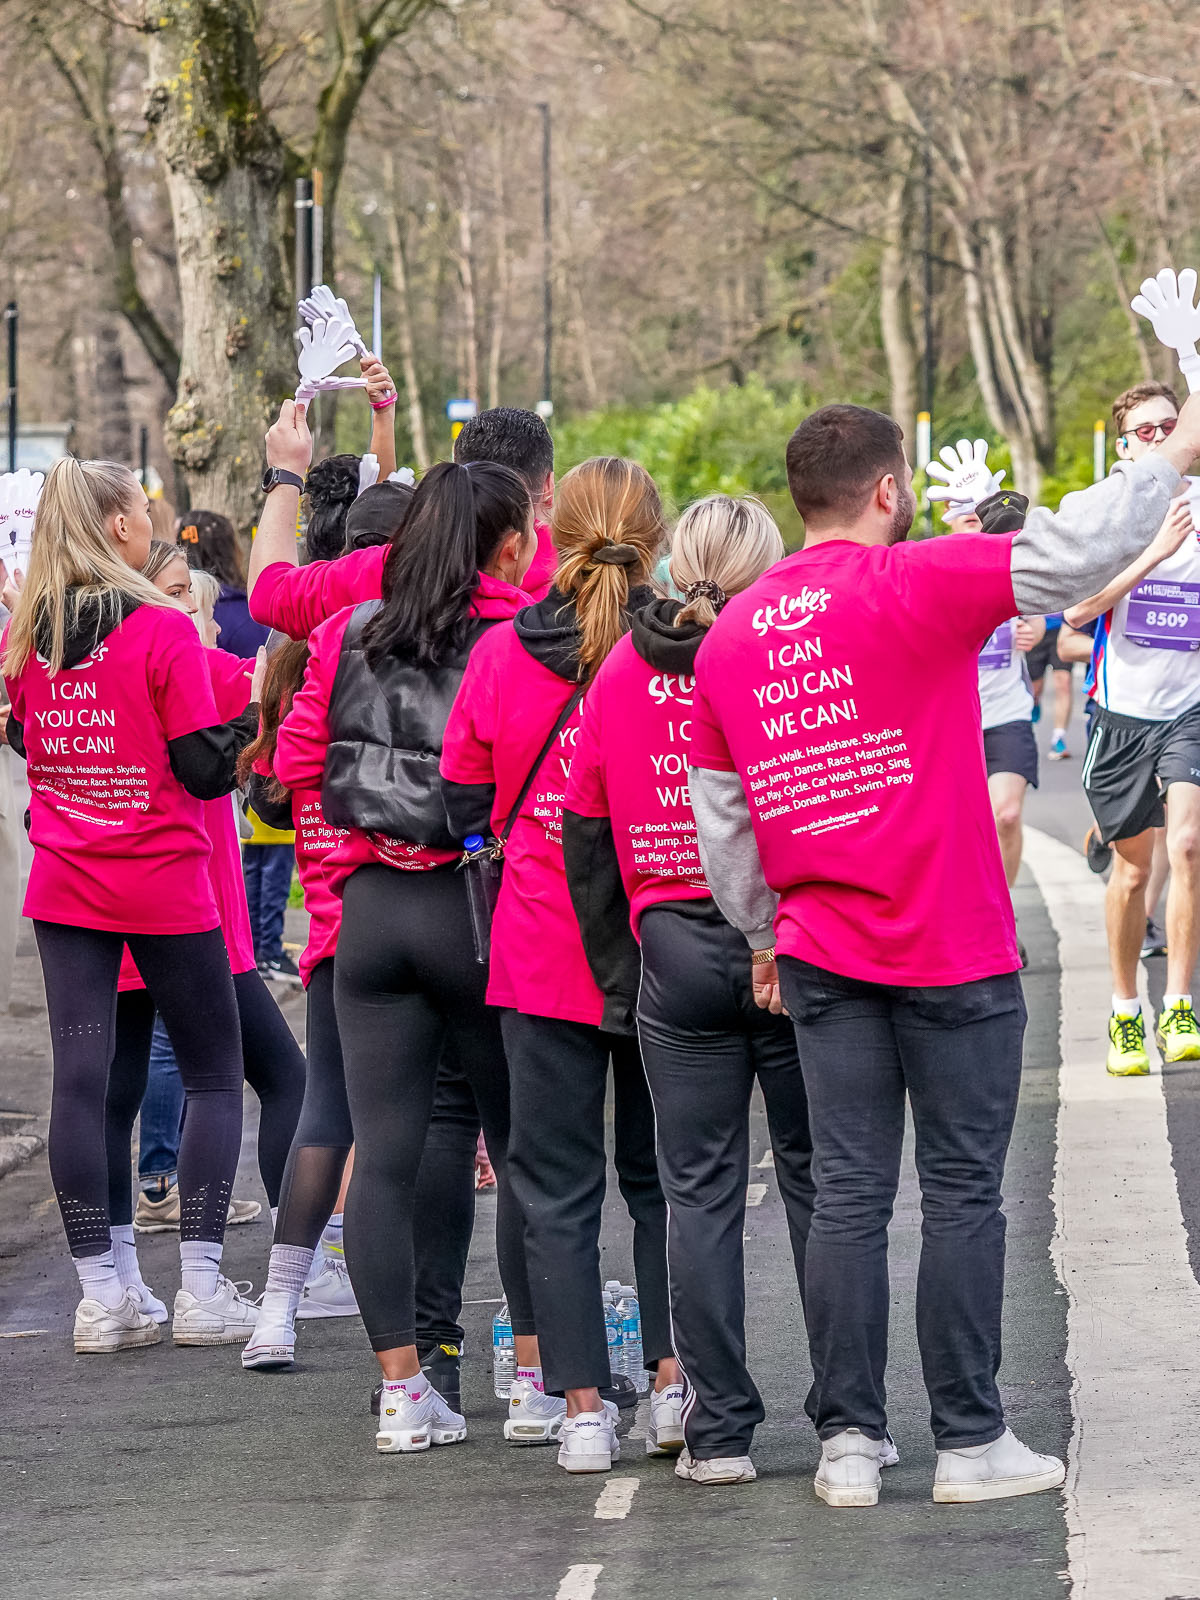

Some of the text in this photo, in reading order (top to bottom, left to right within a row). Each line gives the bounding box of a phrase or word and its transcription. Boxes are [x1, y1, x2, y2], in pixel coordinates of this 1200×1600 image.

[752, 586, 832, 636] St Luke's
[1146, 611, 1189, 628] 8509
[768, 637, 823, 670] I CAN
[51, 682, 96, 700] I CAN
[753, 665, 853, 708] YOU CAN
[35, 709, 115, 728] YOU CAN
[761, 699, 859, 740] WE CAN!
[668, 721, 674, 742] I
[41, 736, 115, 755] WE CAN!
[747, 728, 903, 776] Car Boot. Walk. Headshave. Skydive
[56, 765, 75, 774] Walk.
[76, 765, 115, 774] Headshave.
[117, 765, 146, 776] Skydive
[750, 743, 907, 792] Bake. Jump. Dance. Race. Marathon
[67, 778, 89, 786] Dance.
[90, 778, 109, 786] Race.
[110, 777, 148, 786] Marathon
[754, 757, 912, 807] Eat. Play. Cycle. Car Wash. BBQ. Sing
[90, 789, 150, 799] Wash. BBQ. Sing
[759, 772, 914, 822] Fundraise. Donate. Run. Swim. Party
[108, 801, 131, 810] Swim.
[131, 800, 150, 811] Party
[300, 816, 322, 825] Bake.
[549, 821, 562, 830] Pla
[629, 821, 697, 834] Car Boot. Walk.
[302, 829, 317, 837] Eat.
[318, 828, 333, 838] Play.
[303, 840, 336, 850] Fundraise.
[632, 838, 652, 849] Bake.
[654, 836, 682, 849] Jump.
[634, 850, 698, 864] Eat. Play. Cycle.
[677, 865, 703, 875] Dona
[667, 1391, 683, 1400] prin
[575, 1421, 601, 1429] Reebok
